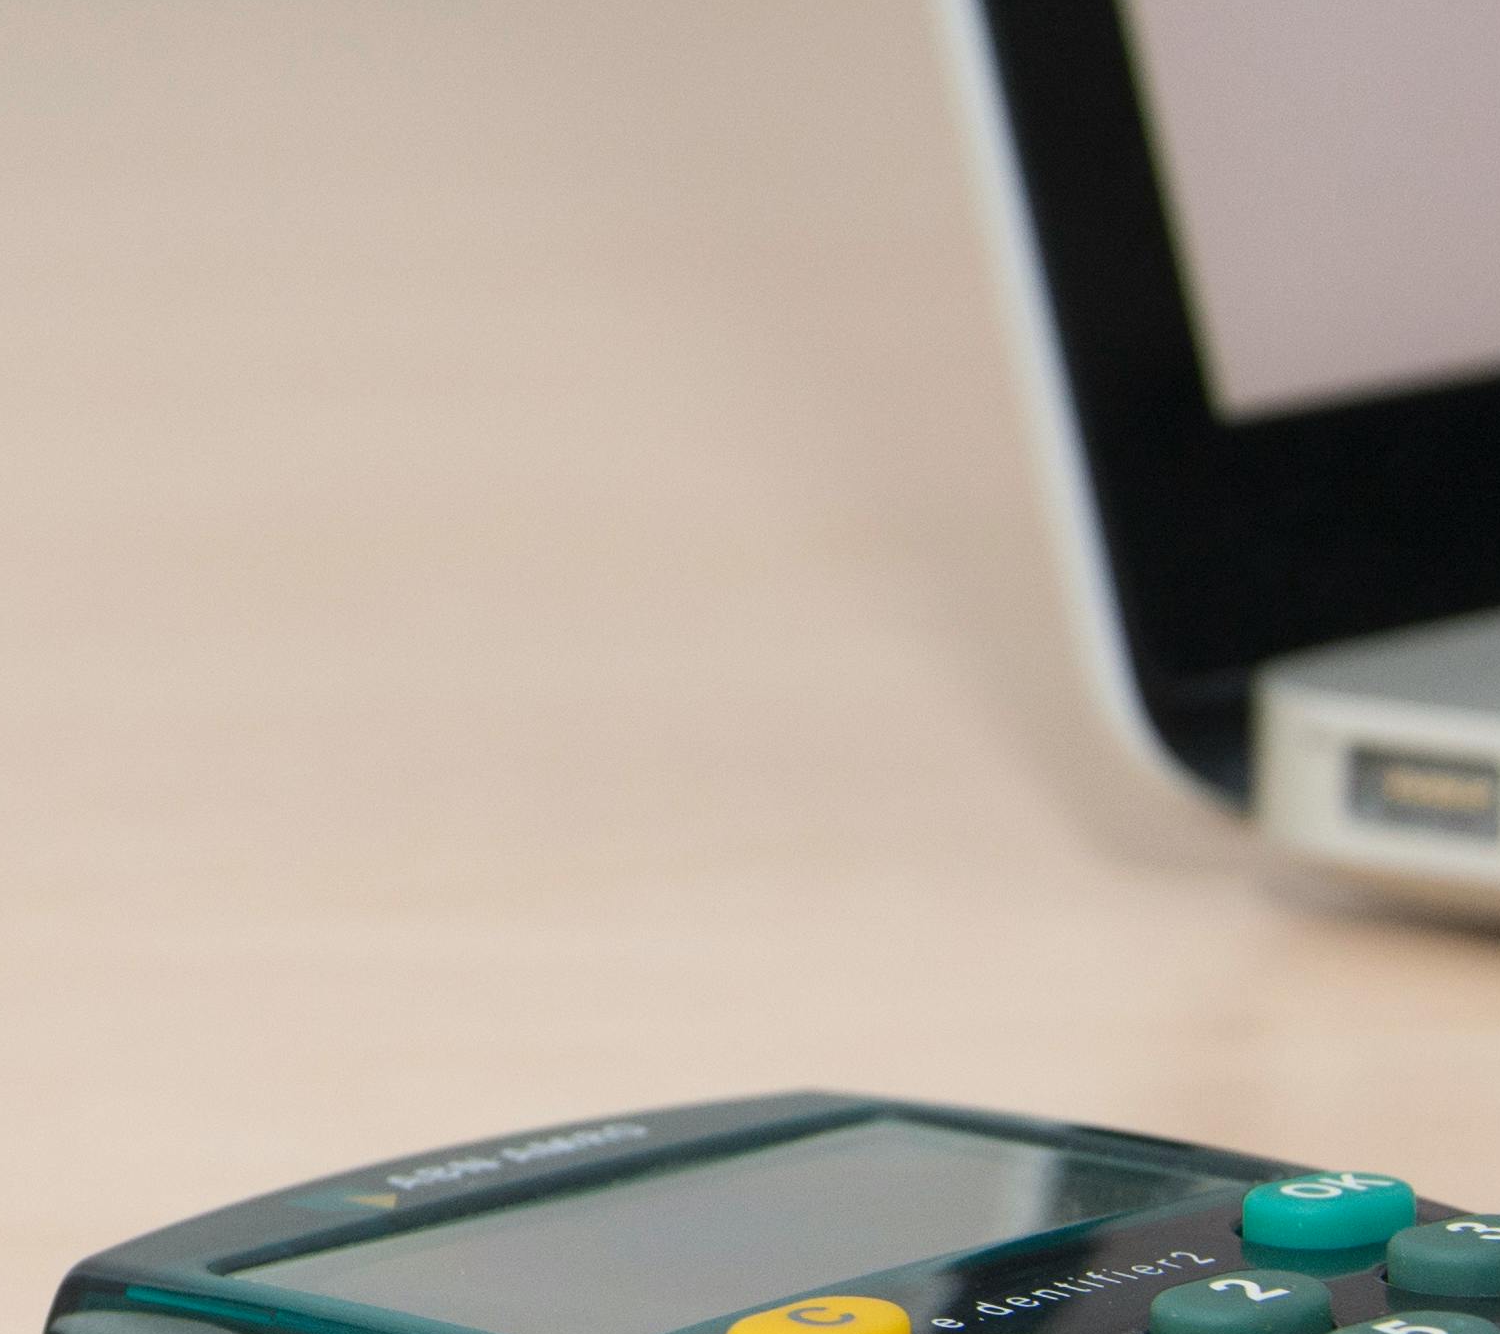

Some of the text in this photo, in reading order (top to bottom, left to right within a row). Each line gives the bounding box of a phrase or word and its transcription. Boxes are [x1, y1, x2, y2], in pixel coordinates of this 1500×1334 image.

[1280, 1173, 1395, 1199] OK
[1208, 1279, 1291, 1302] 2
[787, 1306, 856, 1326] C
